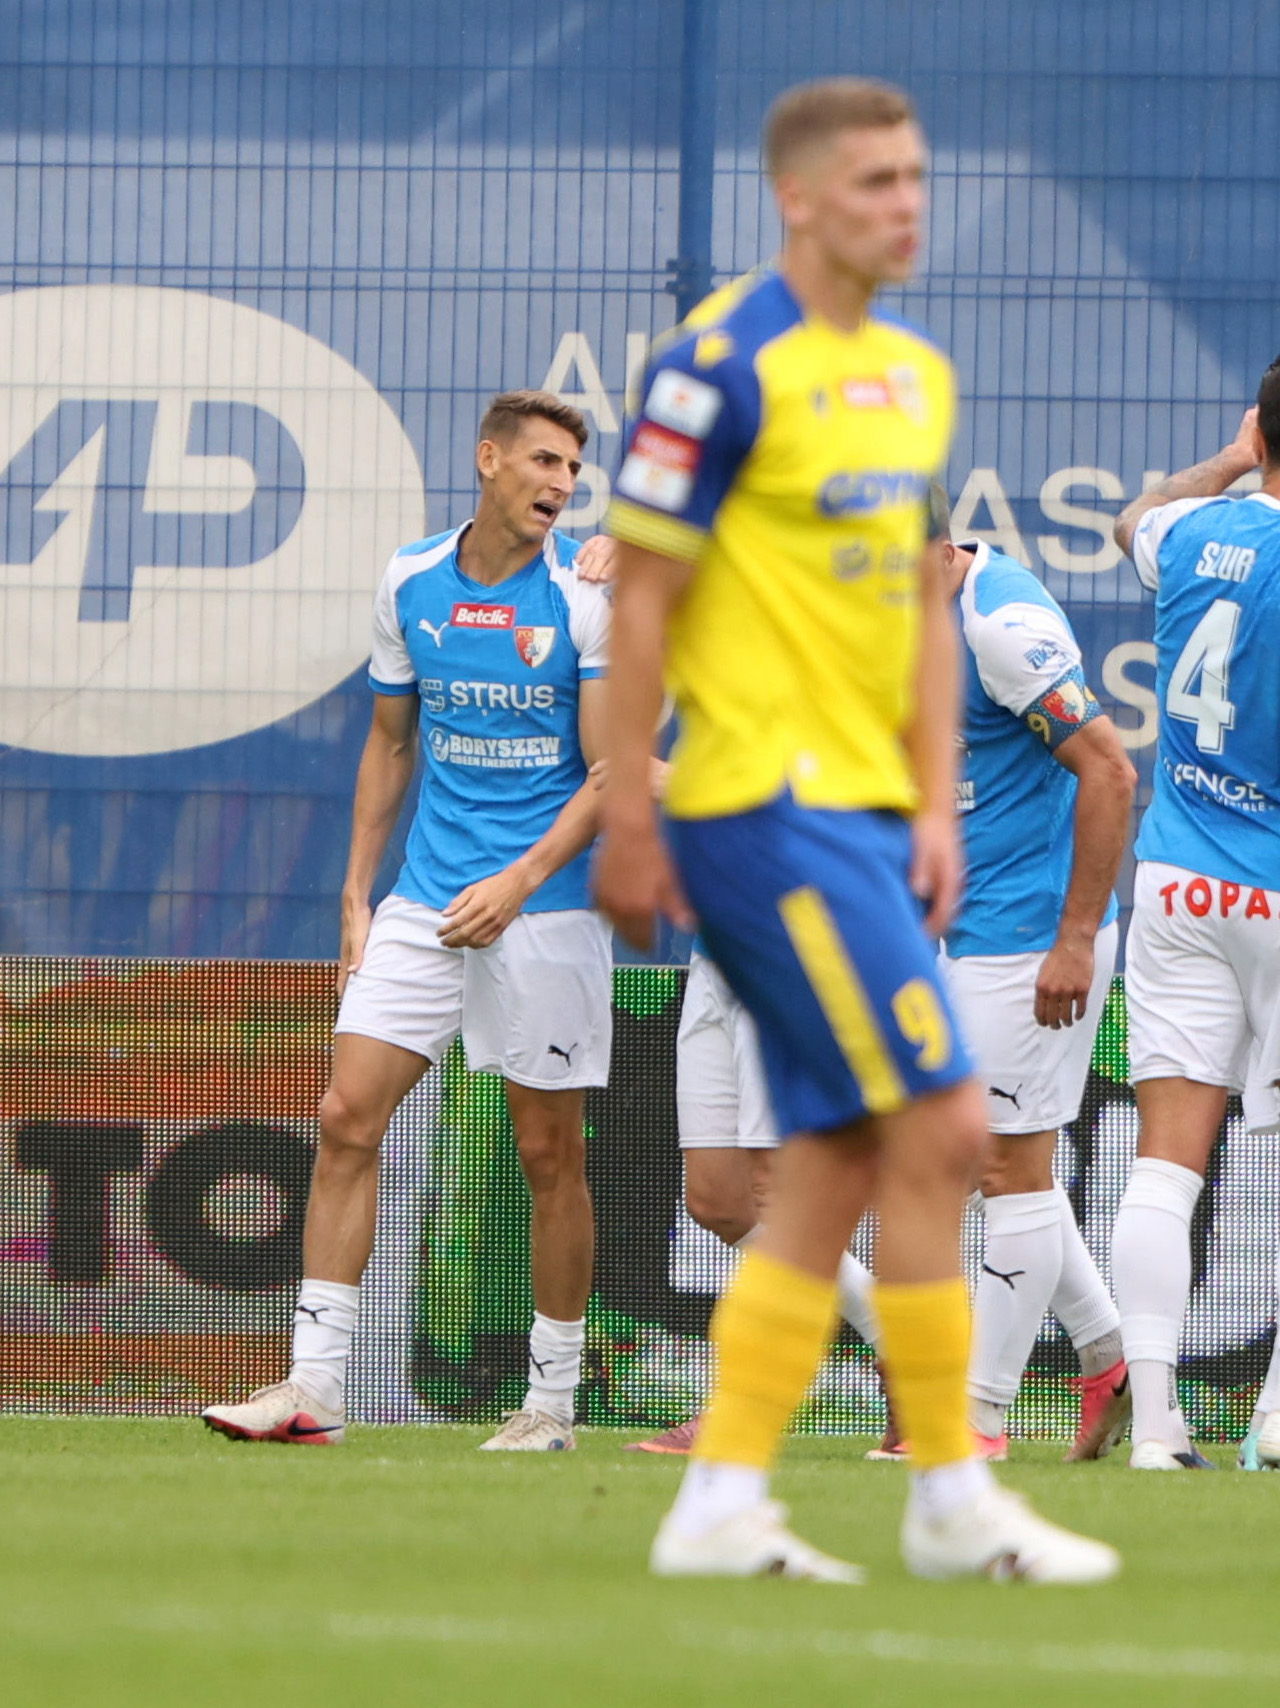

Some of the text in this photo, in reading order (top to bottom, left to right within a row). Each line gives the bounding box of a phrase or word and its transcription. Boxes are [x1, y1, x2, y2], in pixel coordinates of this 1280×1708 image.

[456, 607, 509, 625] Betclic
[1166, 599, 1241, 756] 4
[450, 680, 555, 710] STRUS
[449, 735, 560, 757] BORYSZEW
[535, 755, 560, 767] GAS
[891, 977, 953, 1072] 9
